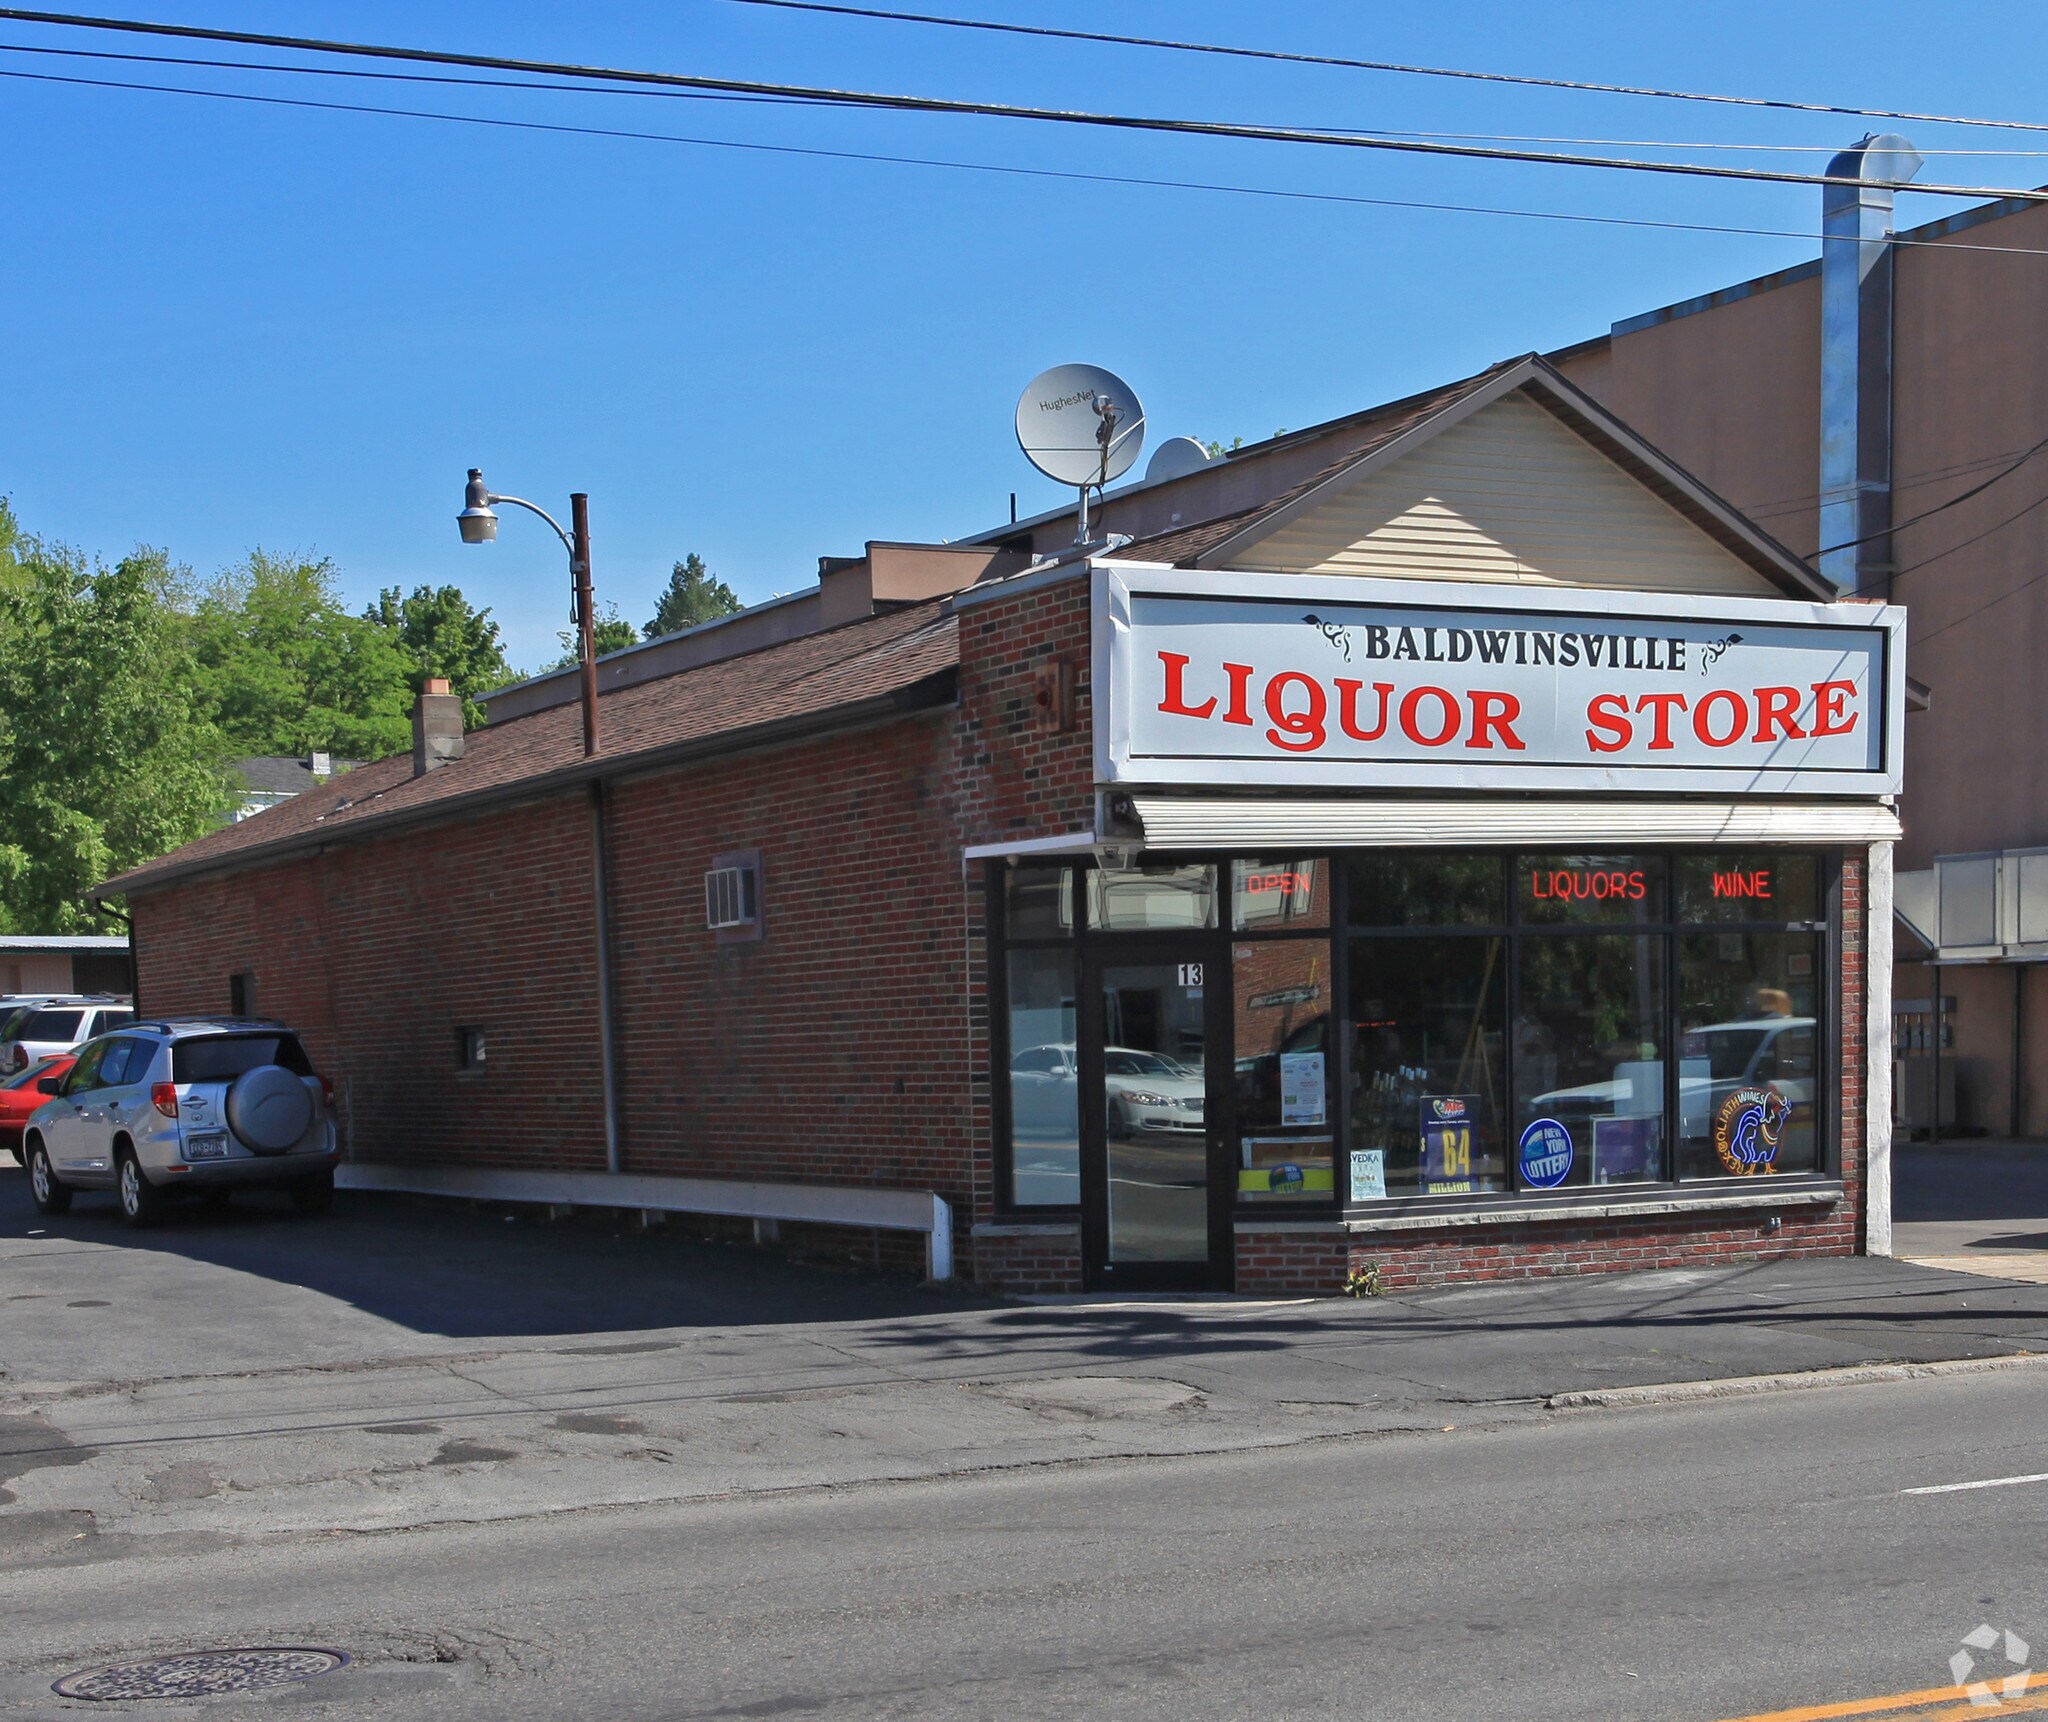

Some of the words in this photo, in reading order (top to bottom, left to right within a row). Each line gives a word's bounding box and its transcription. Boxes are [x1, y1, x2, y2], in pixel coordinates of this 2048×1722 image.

[1039, 389, 1097, 411] HughesNet
[1365, 624, 1686, 671] BALDWINSVILLE
[1157, 650, 1526, 752] LIQUOR
[1585, 679, 1859, 753] STORE
[1248, 872, 1310, 894] OPEN
[1533, 871, 1646, 902] LIQUORS
[1713, 871, 1772, 898] WINE
[1180, 963, 1202, 985] 13
[1544, 1128, 1562, 1139] NEW
[1442, 1130, 1470, 1177] 64
[1546, 1139, 1568, 1154] YORK
[1526, 1152, 1570, 1178] LOTTERY
[1428, 1181, 1471, 1194] MILLION
